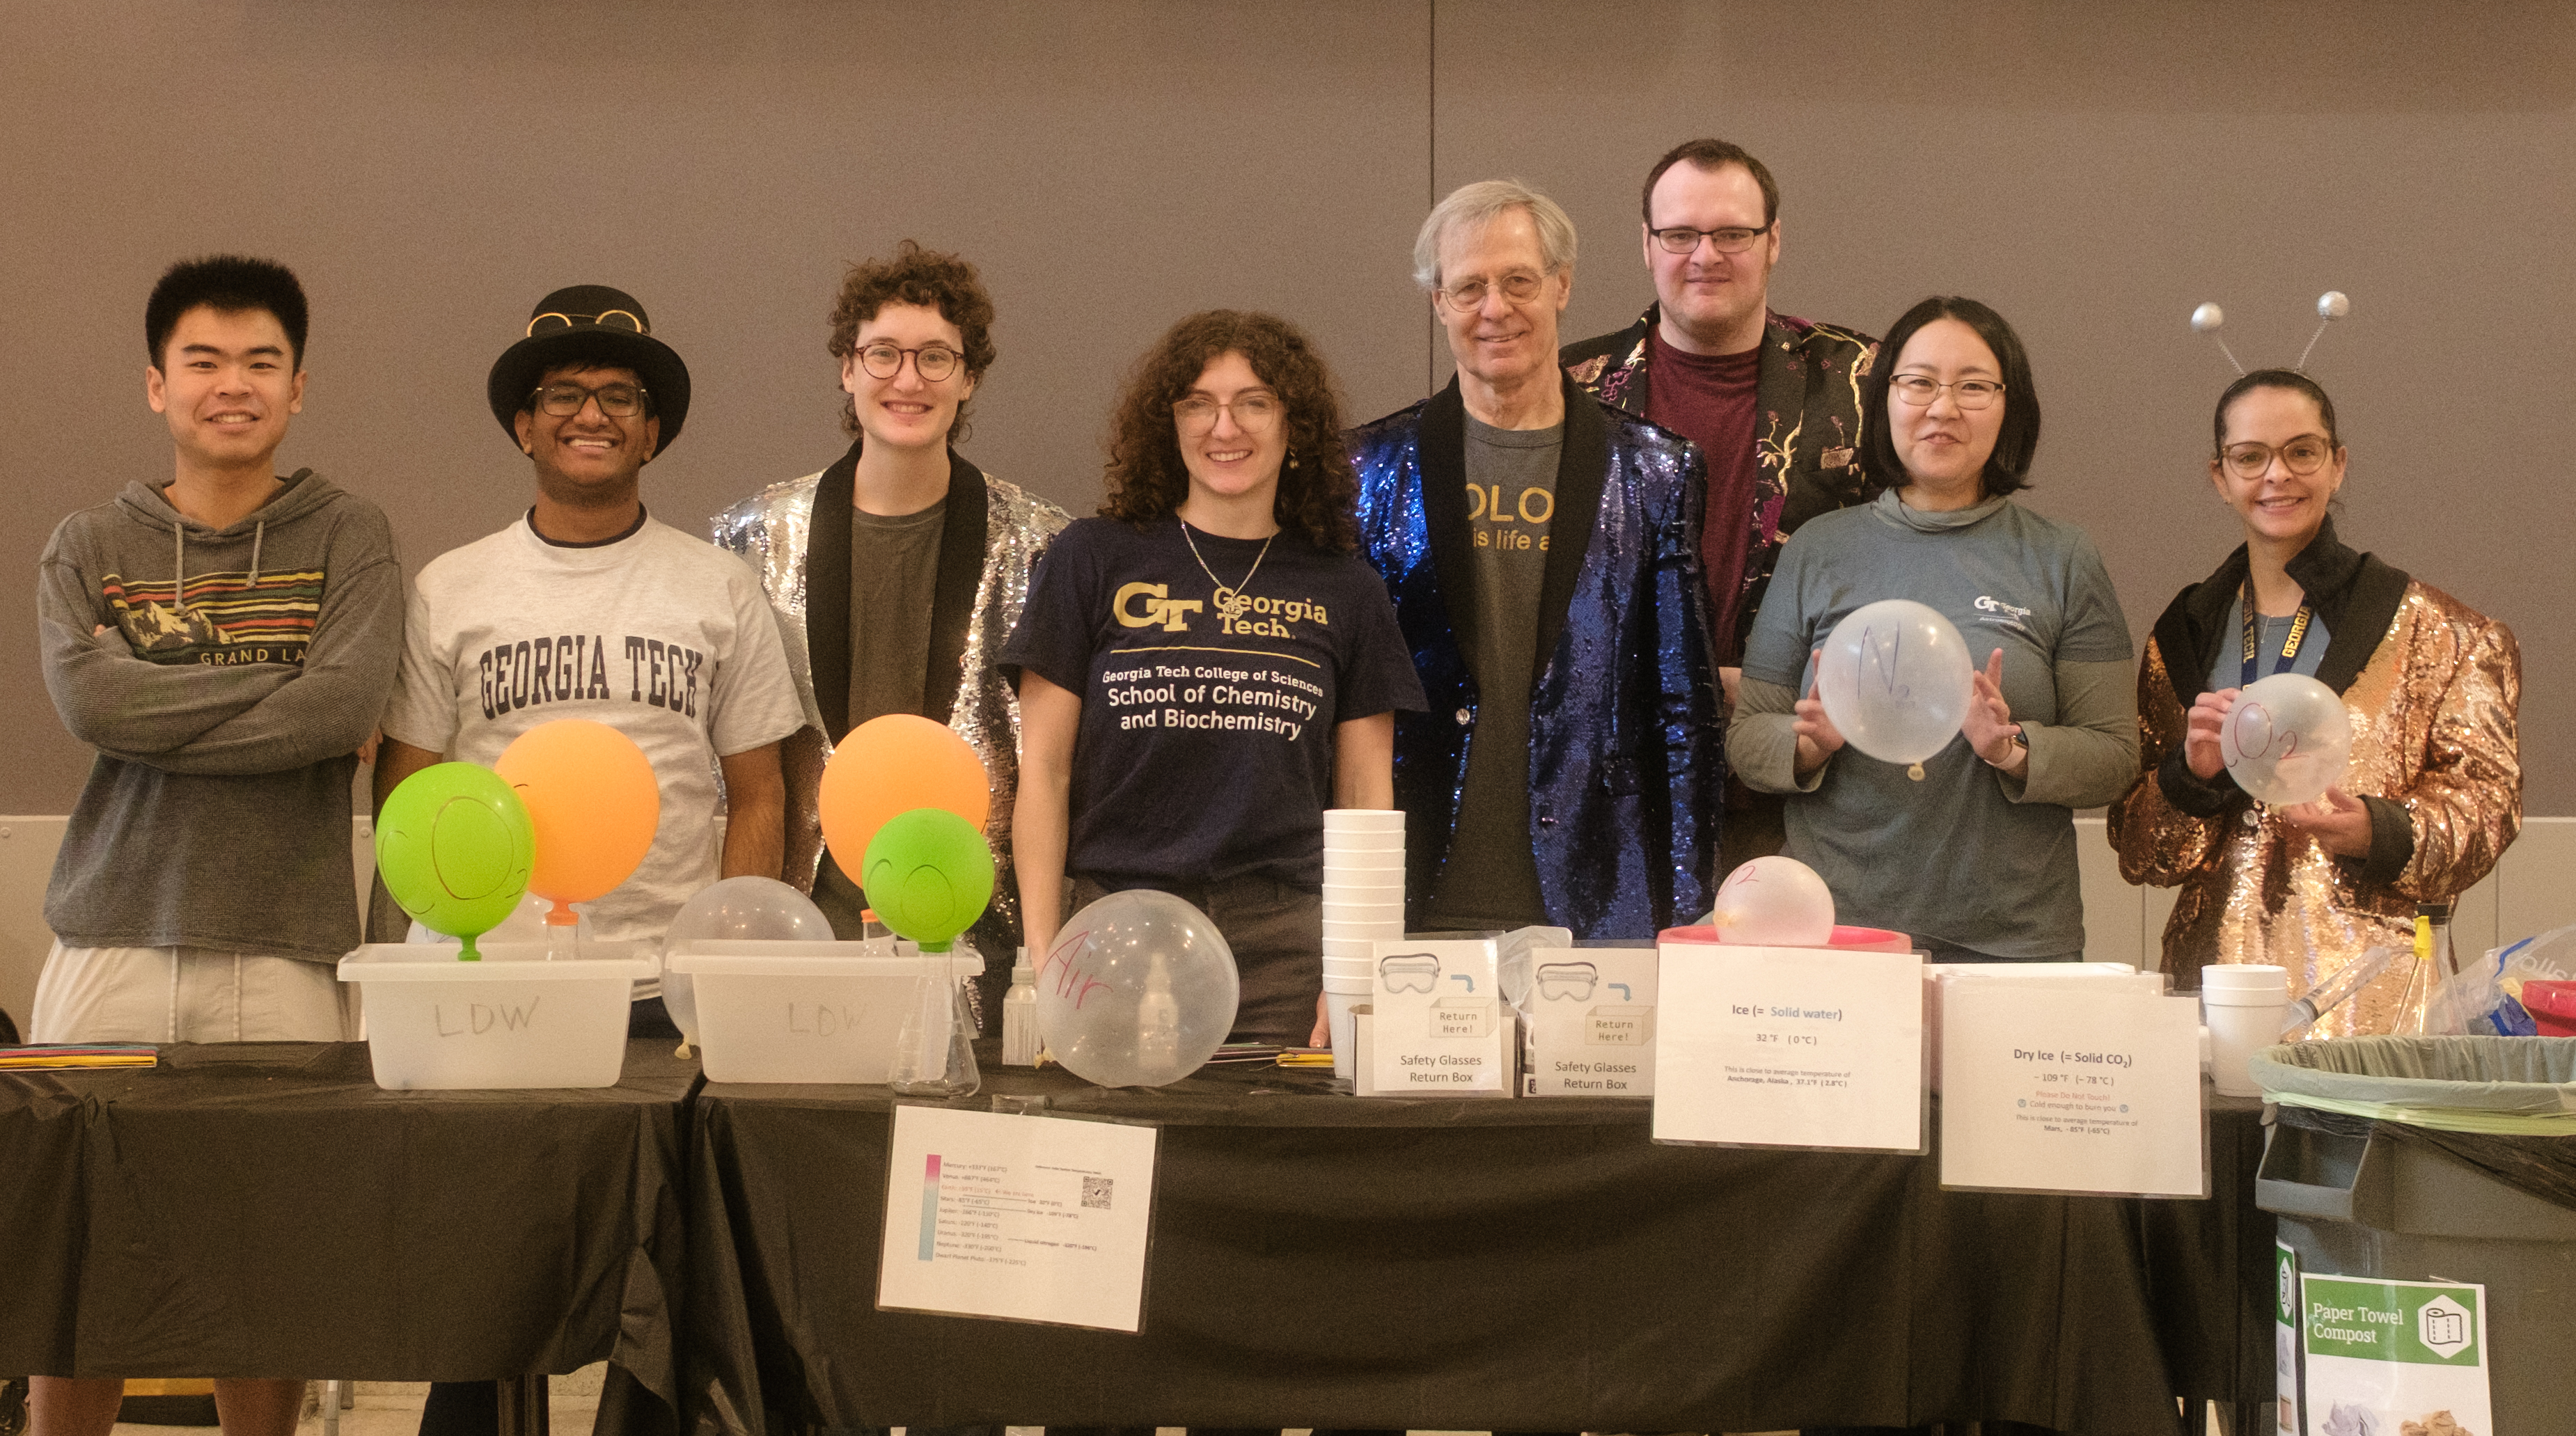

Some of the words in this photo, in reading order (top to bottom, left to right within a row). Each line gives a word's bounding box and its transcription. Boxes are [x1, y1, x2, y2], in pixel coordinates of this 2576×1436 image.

[1496, 529, 1531, 550] life
[1113, 581, 1203, 632] GT
[1213, 587, 1328, 626] Georgia
[1974, 596, 2000, 612] GT
[2282, 606, 2311, 658] GEORGIA
[201, 648, 269, 665] GRAND
[480, 635, 610, 720] GEORGIA
[625, 636, 703, 718] TECH
[1102, 667, 1152, 684] Georgia
[1156, 665, 1190, 678] Tech
[1195, 667, 1249, 682] College
[1252, 670, 1268, 681] of
[1271, 671, 1324, 697] Sciences
[1108, 684, 1176, 707] School
[1184, 685, 1207, 703] of
[1212, 686, 1317, 720] Chemistry
[1120, 709, 1156, 730] and
[1164, 709, 1301, 741] Biochemistry
[1041, 931, 1113, 1009] Air
[435, 995, 540, 1037] LDW
[789, 1002, 868, 1036] LDW
[1440, 1012, 1477, 1021] Return
[1732, 1004, 1749, 1015] Ice
[1770, 1007, 1800, 1018] Solid
[1803, 1009, 1842, 1022] water)
[1443, 1025, 1472, 1034] Here!
[1596, 1020, 1633, 1029] Return
[1598, 1032, 1628, 1041] Here!
[1400, 1055, 1436, 1068] Safety
[1439, 1055, 1482, 1066] Glasses
[2014, 1049, 2034, 1062] Dry
[2038, 1050, 2054, 1060] Ice
[2075, 1052, 2103, 1064] Solid
[1410, 1072, 1448, 1082] Return
[1452, 1072, 1473, 1082] Box
[1555, 1061, 1591, 1074] Safety
[1594, 1062, 1637, 1073] Glasses
[1564, 1078, 1602, 1089] Return
[1606, 1079, 1628, 1089] Box
[2048, 1102, 2074, 1110] enough
[2313, 1302, 2355, 1323] Paper
[2357, 1306, 2404, 1325] Towel
[2314, 1323, 2378, 1345] Compost
